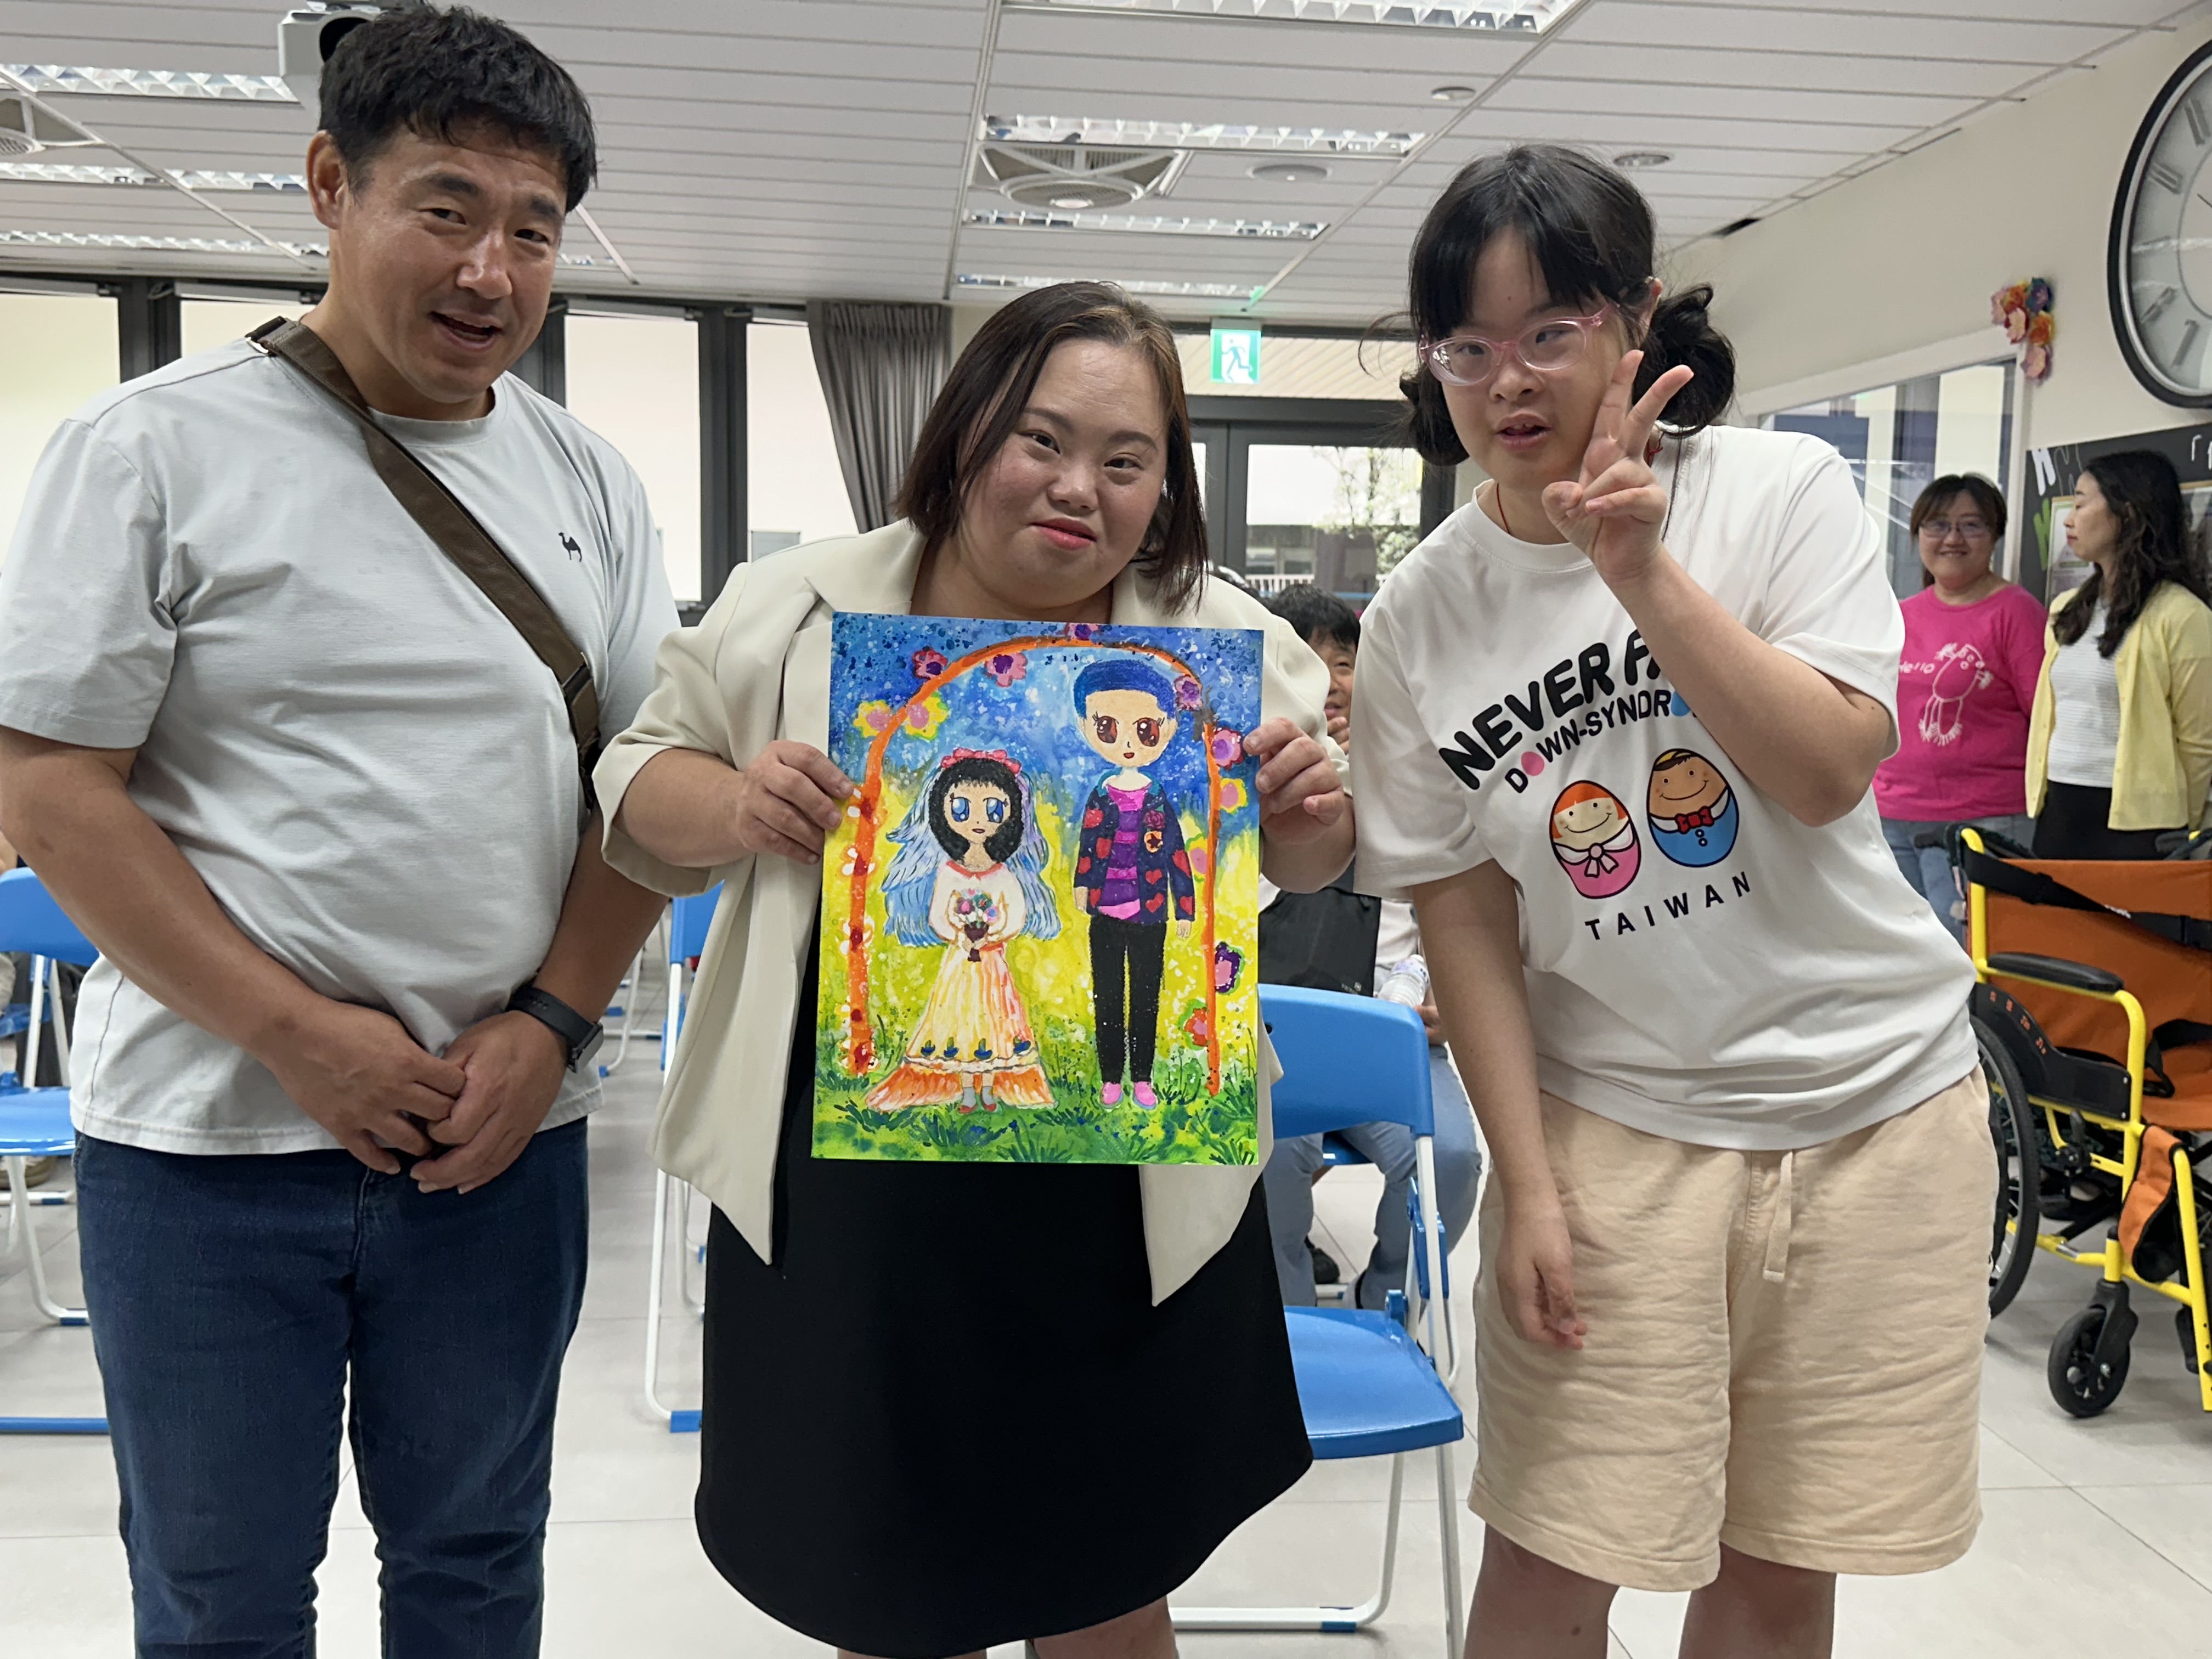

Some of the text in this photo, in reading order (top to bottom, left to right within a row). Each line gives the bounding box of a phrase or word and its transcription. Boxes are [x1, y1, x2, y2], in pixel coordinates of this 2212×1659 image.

[1438, 642, 1615, 791] NEVER
[1504, 689, 1697, 794] DOWN-SYNDRO
[1584, 871, 1751, 940] TAIWAN
